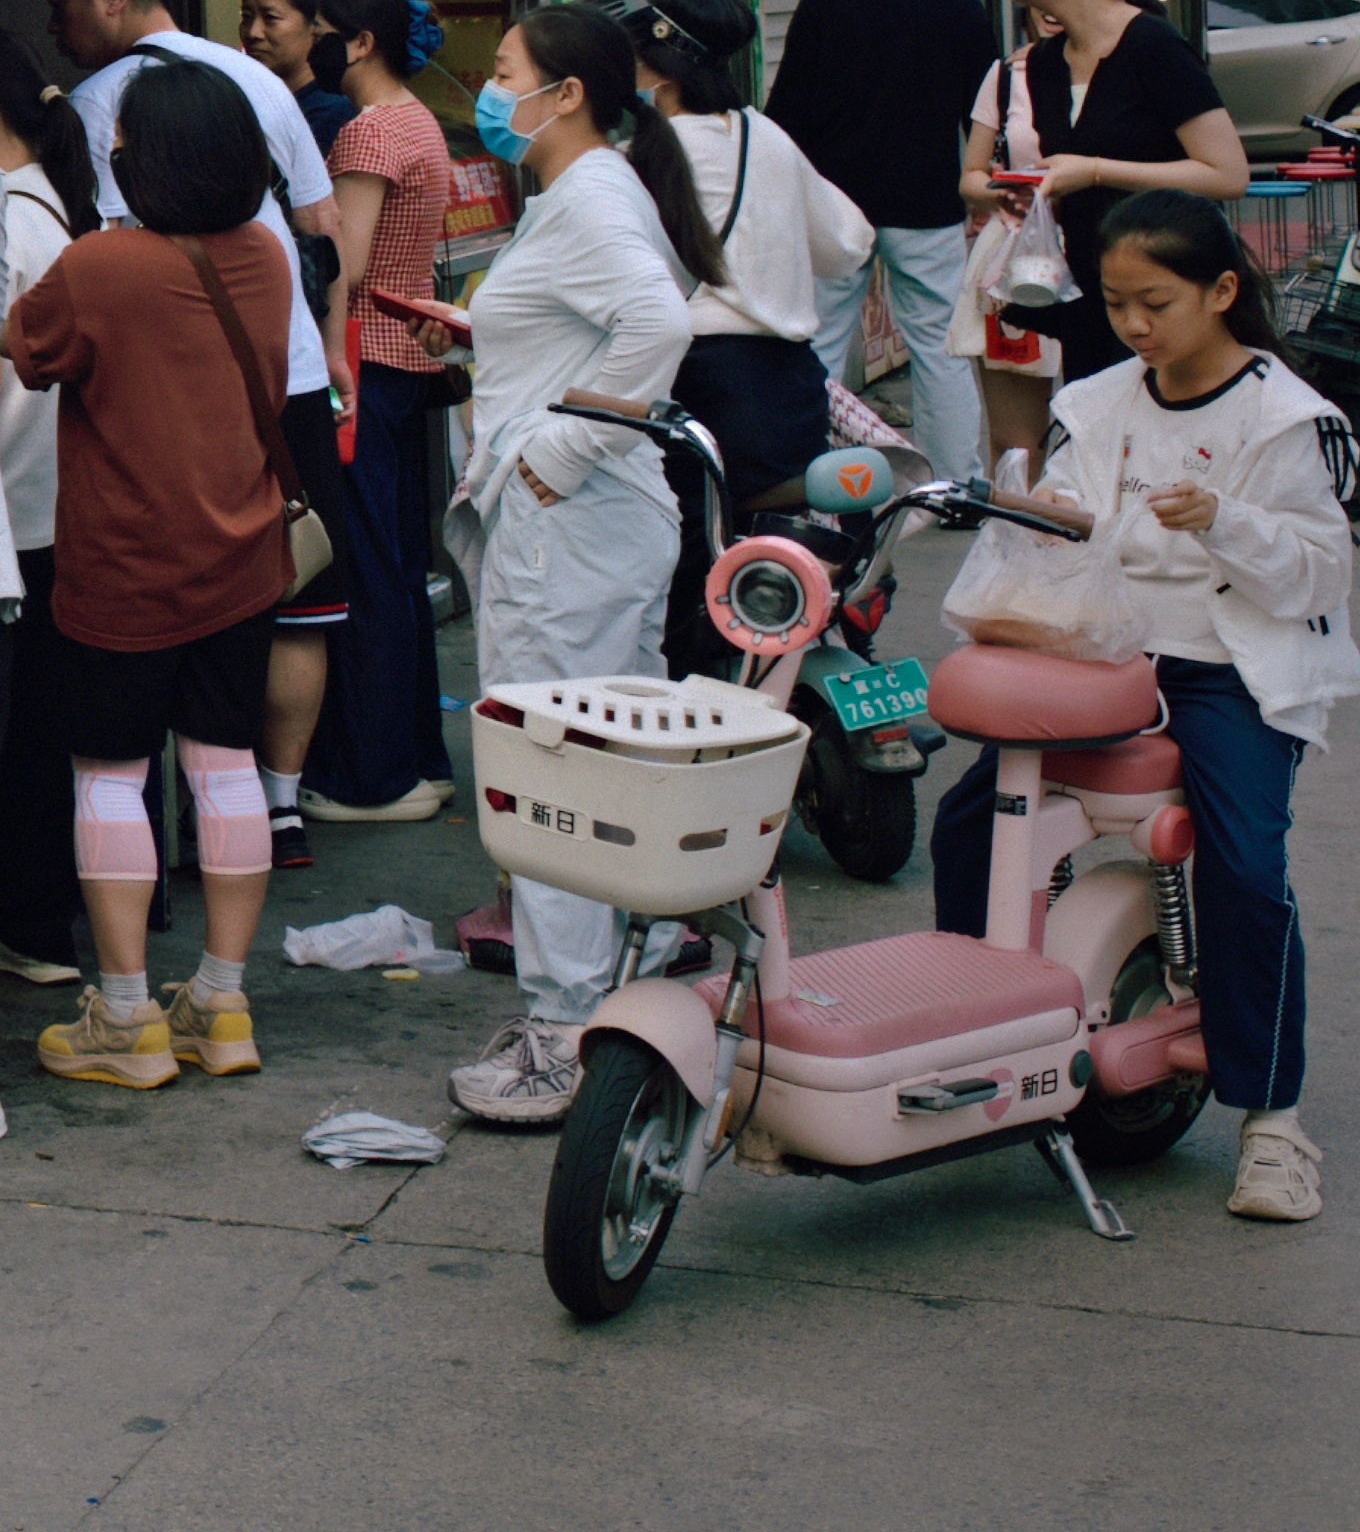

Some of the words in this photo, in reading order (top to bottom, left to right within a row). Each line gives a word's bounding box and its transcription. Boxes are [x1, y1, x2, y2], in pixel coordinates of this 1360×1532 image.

[844, 687, 927, 723] 761390
[530, 800, 576, 835] 新日
[1021, 1068, 1058, 1102] 新日
